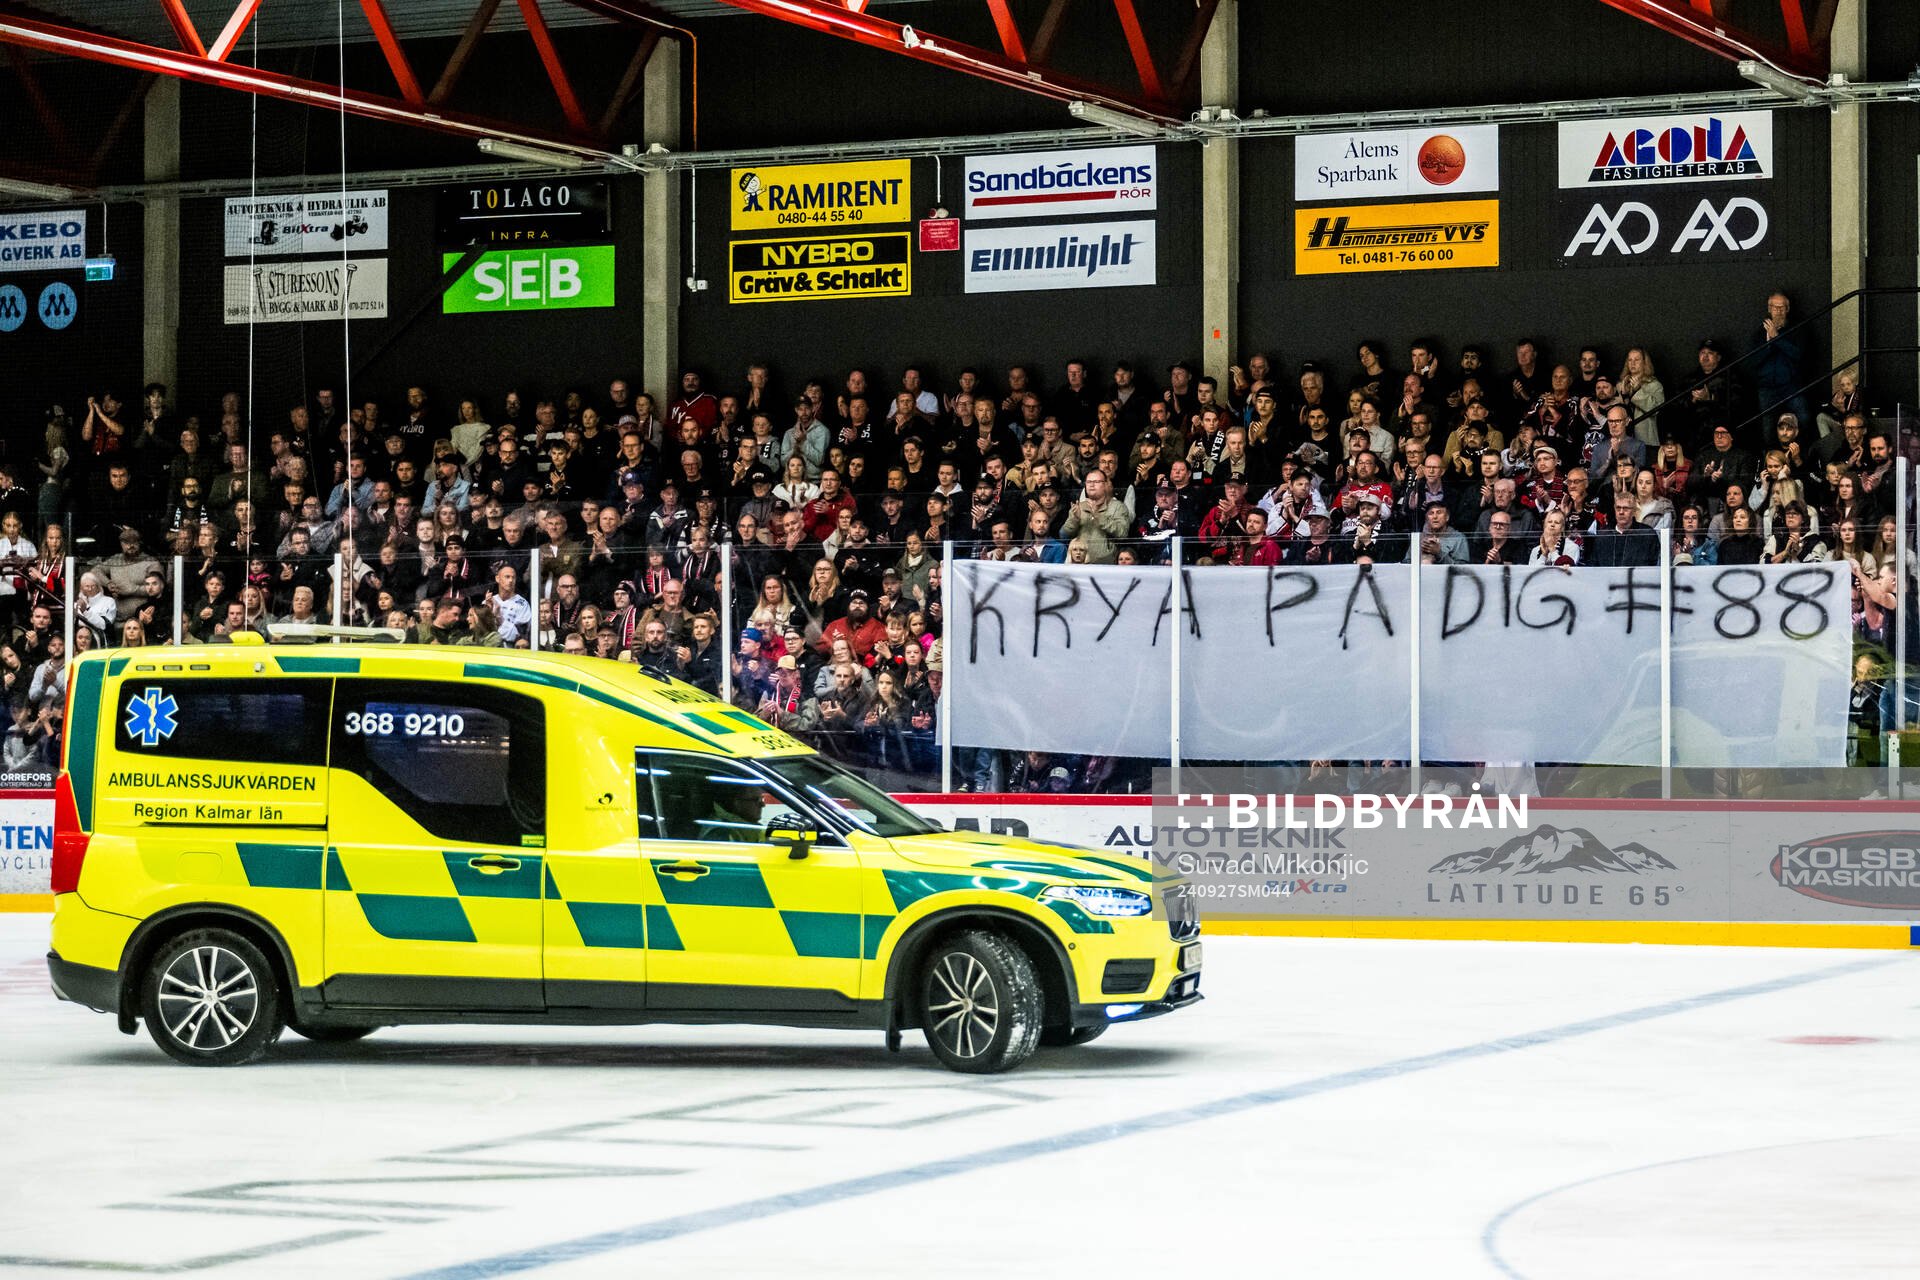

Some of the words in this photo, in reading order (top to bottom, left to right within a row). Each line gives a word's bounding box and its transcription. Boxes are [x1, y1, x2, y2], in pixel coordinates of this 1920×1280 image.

[1344, 138, 1399, 159] Ålems
[1594, 117, 1756, 167] AGONA
[968, 162, 1152, 193] Sandbäckens
[1317, 164, 1399, 187] Sparbank
[1603, 163, 1717, 180] FASTIGHETER
[1726, 162, 1745, 174] AB
[470, 185, 570, 210] TOLAGO
[768, 178, 903, 211] RAMIRENT
[1120, 187, 1151, 199] RÖR
[226, 203, 294, 216] AUTOTEKNIK
[307, 198, 368, 211] HYDRAULIK
[371, 197, 386, 208] AB
[777, 211, 827, 225] 0480-44
[830, 211, 845, 222] 55
[848, 209, 863, 221] 40
[0, 222, 82, 240] KEBO
[282, 224, 329, 235] BilXtra
[491, 231, 550, 241] INFRA
[1, 245, 55, 261] GVERK
[60, 244, 82, 258] AB
[762, 241, 874, 267] NYBRO
[1338, 253, 1360, 265] Tel.
[1363, 251, 1416, 264] 0481-76
[1419, 250, 1434, 262] 60
[1437, 249, 1454, 261] 00
[268, 268, 340, 299] STURESSONS
[473, 258, 583, 302] SEB
[816, 267, 902, 291] Schakt
[268, 301, 291, 314] BYGG
[293, 302, 301, 312] &
[302, 300, 325, 312] MARK
[327, 300, 339, 311] AB
[1441, 564, 1577, 641] DIG
[344, 712, 394, 734] 368
[404, 713, 464, 736] 9210
[0, 773, 52, 782] ORREFORS
[108, 772, 316, 791] AMBULANSSJUKVÅRDEN
[134, 803, 188, 820] Region
[195, 805, 252, 819] Kalmar
[260, 806, 283, 820] län
[0, 825, 53, 850] TEN
[1104, 825, 1347, 849] AUTOTEKNIK
[1781, 846, 1920, 870] KOLSB
[1427, 882, 1604, 905] LATITUDE
